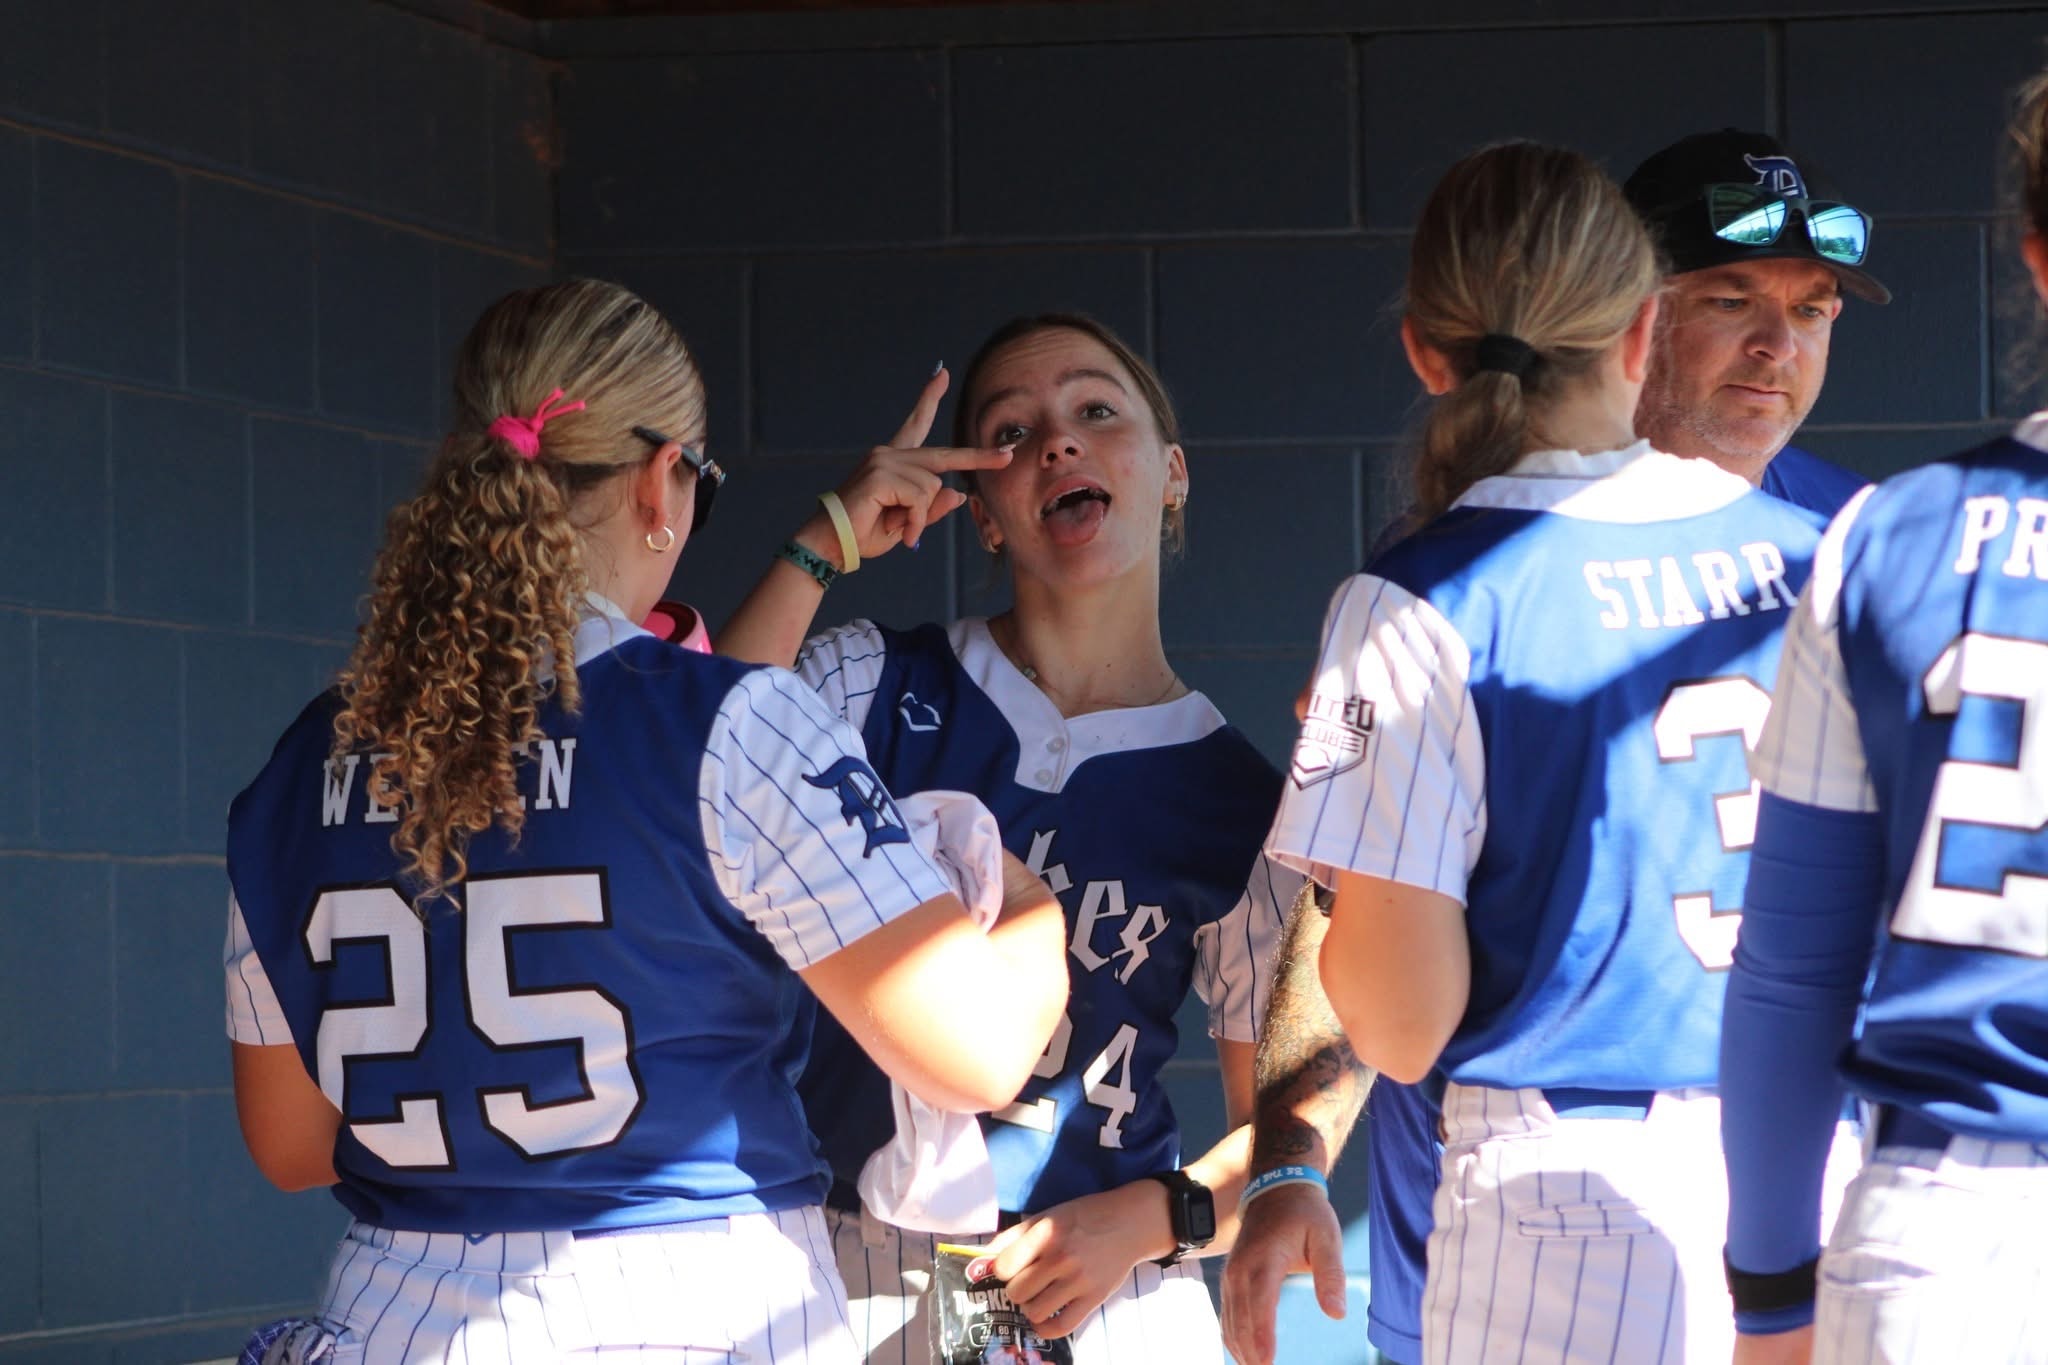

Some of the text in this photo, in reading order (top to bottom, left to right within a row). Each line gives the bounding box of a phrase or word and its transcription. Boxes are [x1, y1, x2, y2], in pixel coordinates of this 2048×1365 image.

[1583, 540, 1799, 630] STARR
[322, 737, 577, 828] WEN
[801, 755, 911, 860] D
[1653, 672, 1773, 974] 3
[305, 866, 648, 1172] 25
